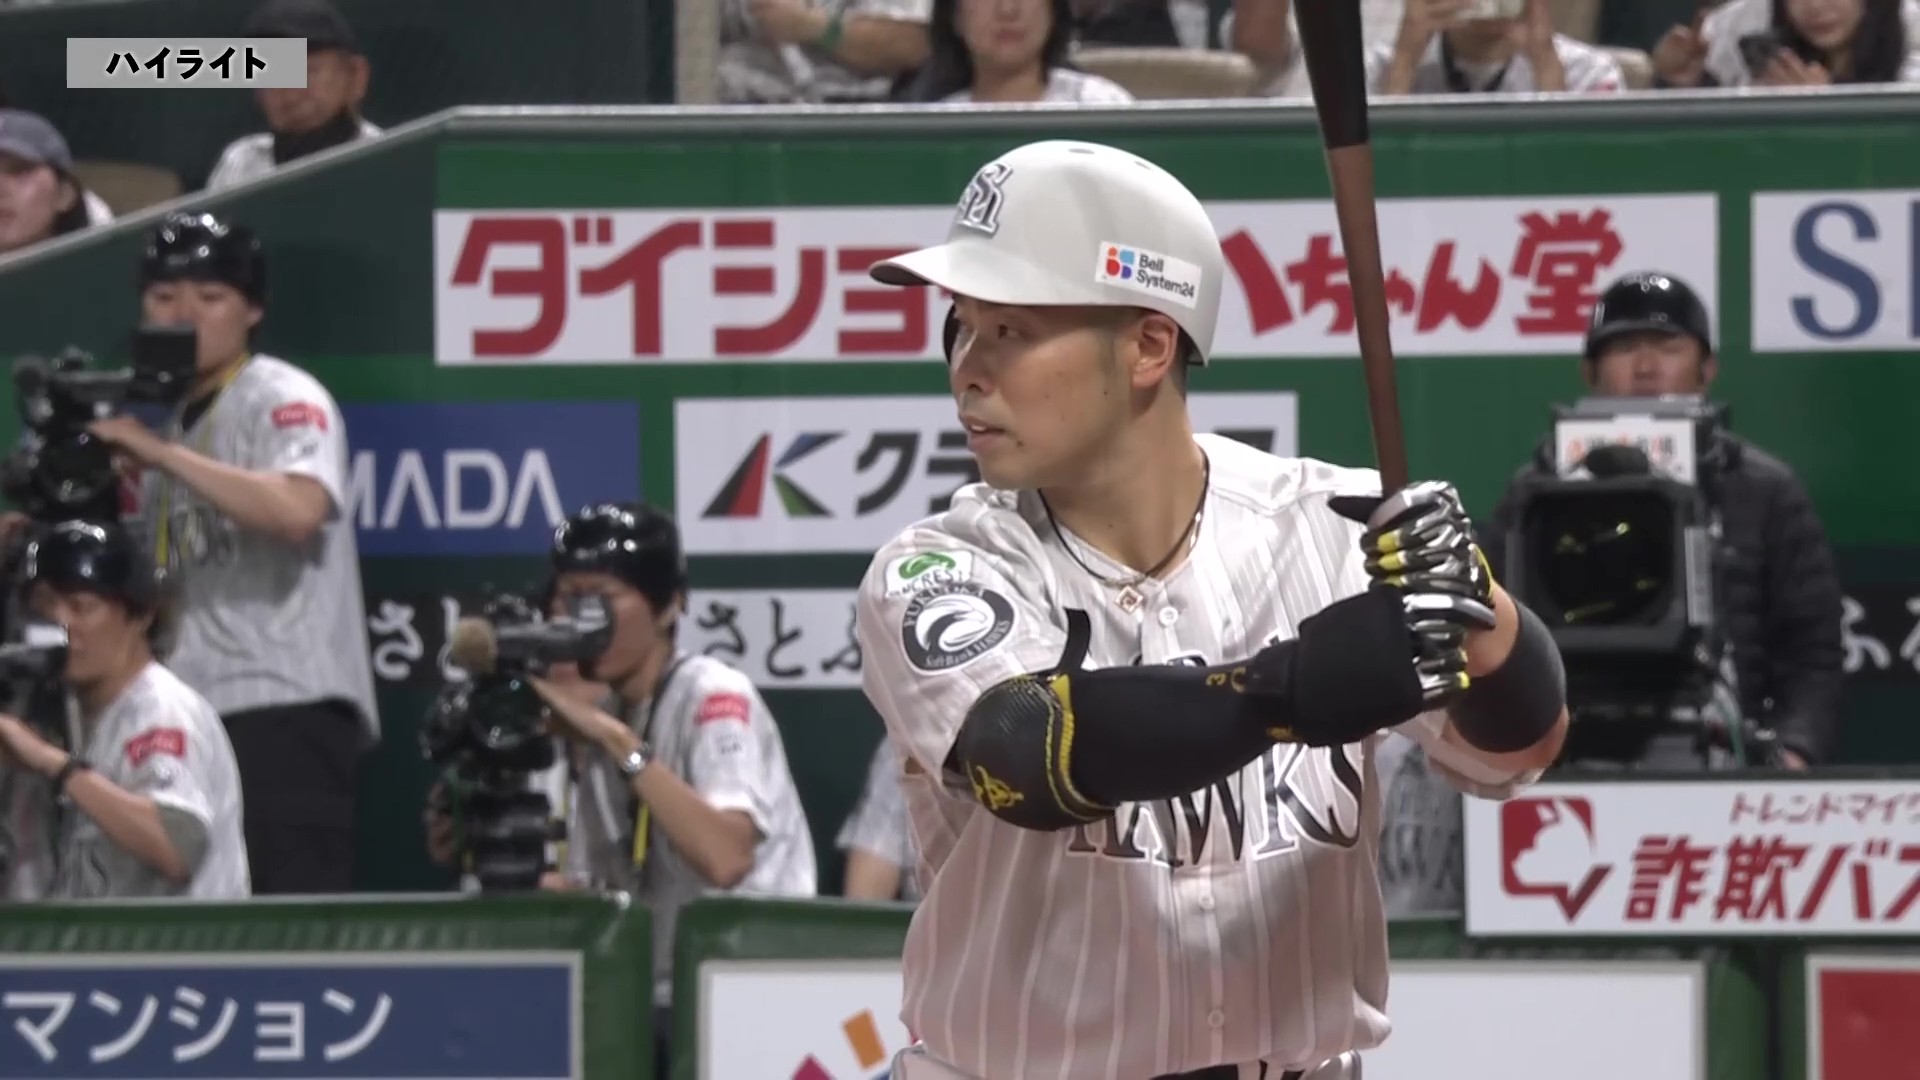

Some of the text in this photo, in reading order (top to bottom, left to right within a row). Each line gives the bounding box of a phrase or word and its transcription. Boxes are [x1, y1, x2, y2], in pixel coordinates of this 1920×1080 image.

[450, 216, 950, 357] ダイショ
[1136, 269, 1195, 298] System24
[1139, 253, 1164, 273] Bell
[1790, 201, 1920, 341] S
[3, 988, 393, 1062] マンション
